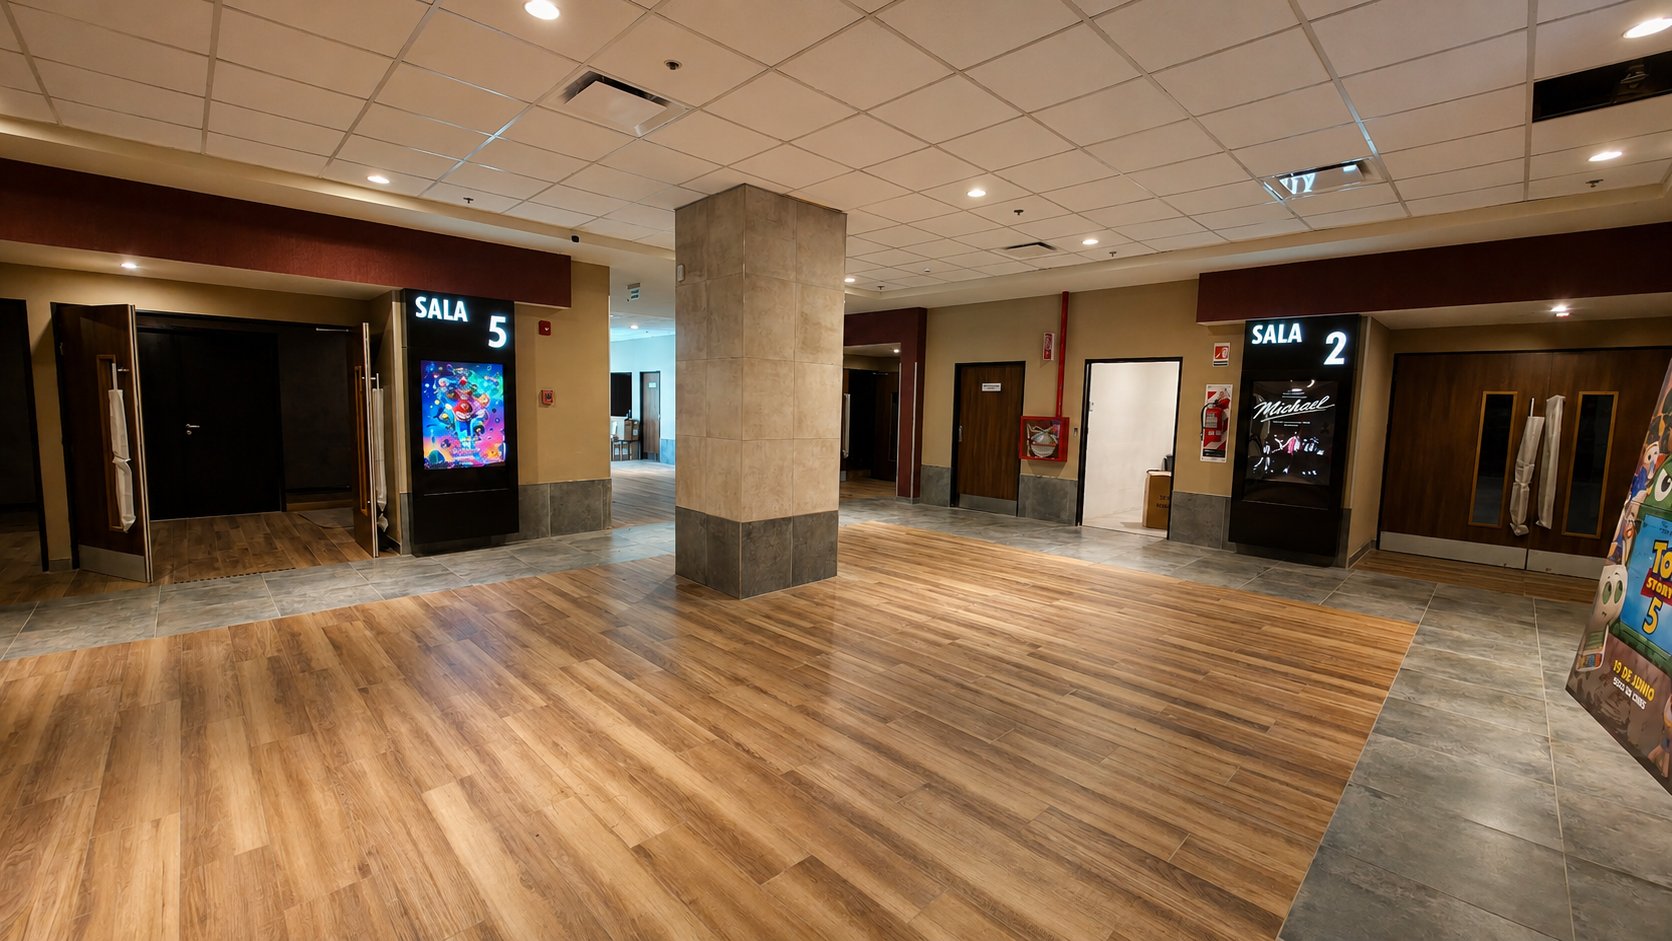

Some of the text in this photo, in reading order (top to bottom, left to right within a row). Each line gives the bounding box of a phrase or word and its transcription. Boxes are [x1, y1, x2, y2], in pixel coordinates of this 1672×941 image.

[415, 296, 507, 348] SALA 5
[1251, 323, 1347, 365] SALA 2
[1253, 395, 1335, 420] Michael
[1652, 539, 1672, 579] TO
[1642, 596, 1663, 635] 5
[1613, 660, 1655, 701] 19 DE JUNIO
